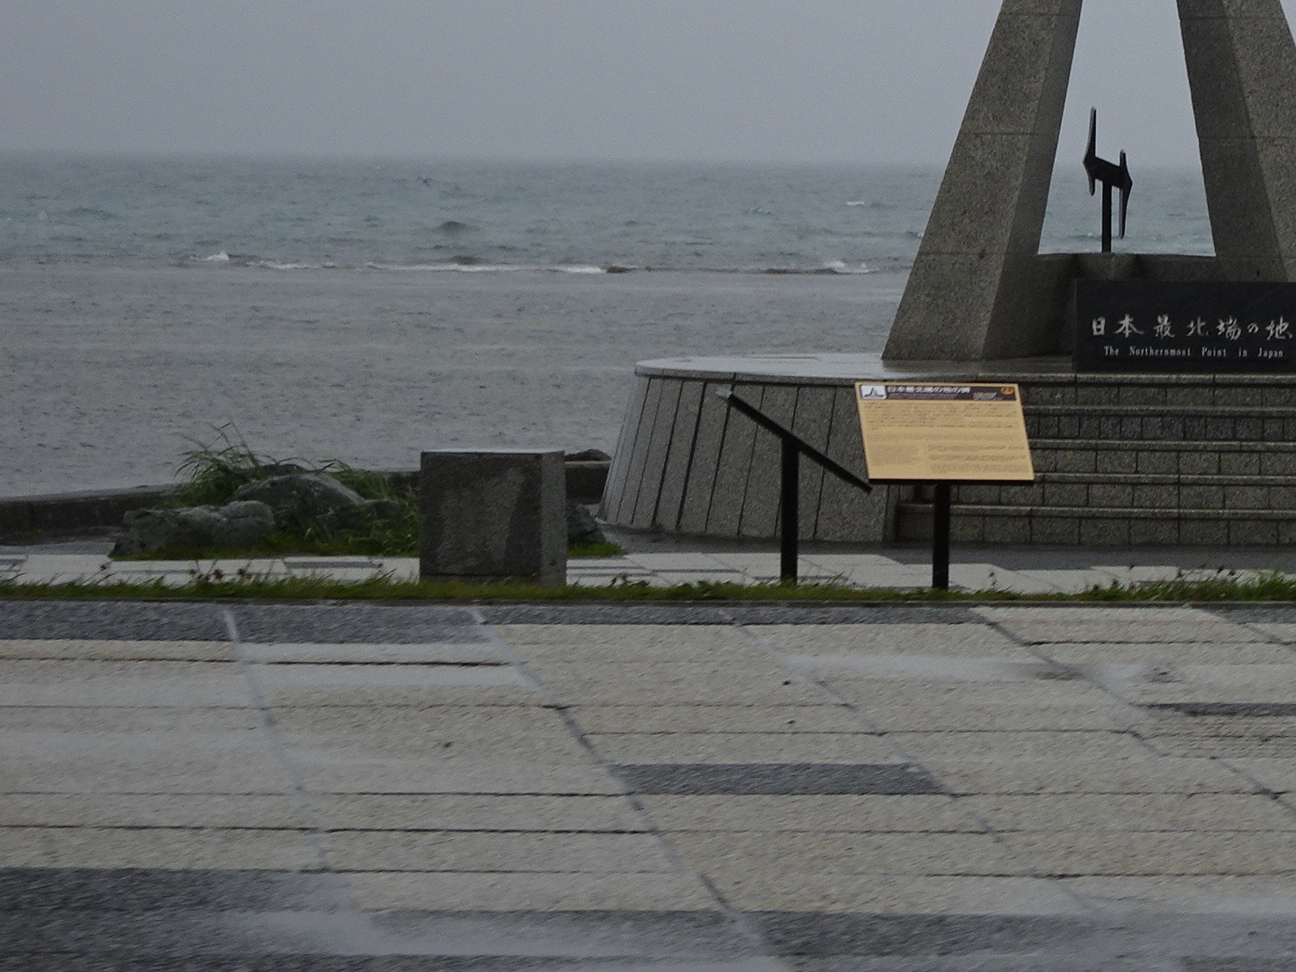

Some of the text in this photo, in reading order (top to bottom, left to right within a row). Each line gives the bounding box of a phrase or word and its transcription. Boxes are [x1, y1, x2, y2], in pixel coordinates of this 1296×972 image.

[1091, 313, 1294, 341] 日本最北端の地
[1103, 345, 1284, 360] The Northernmost Point in Japan
